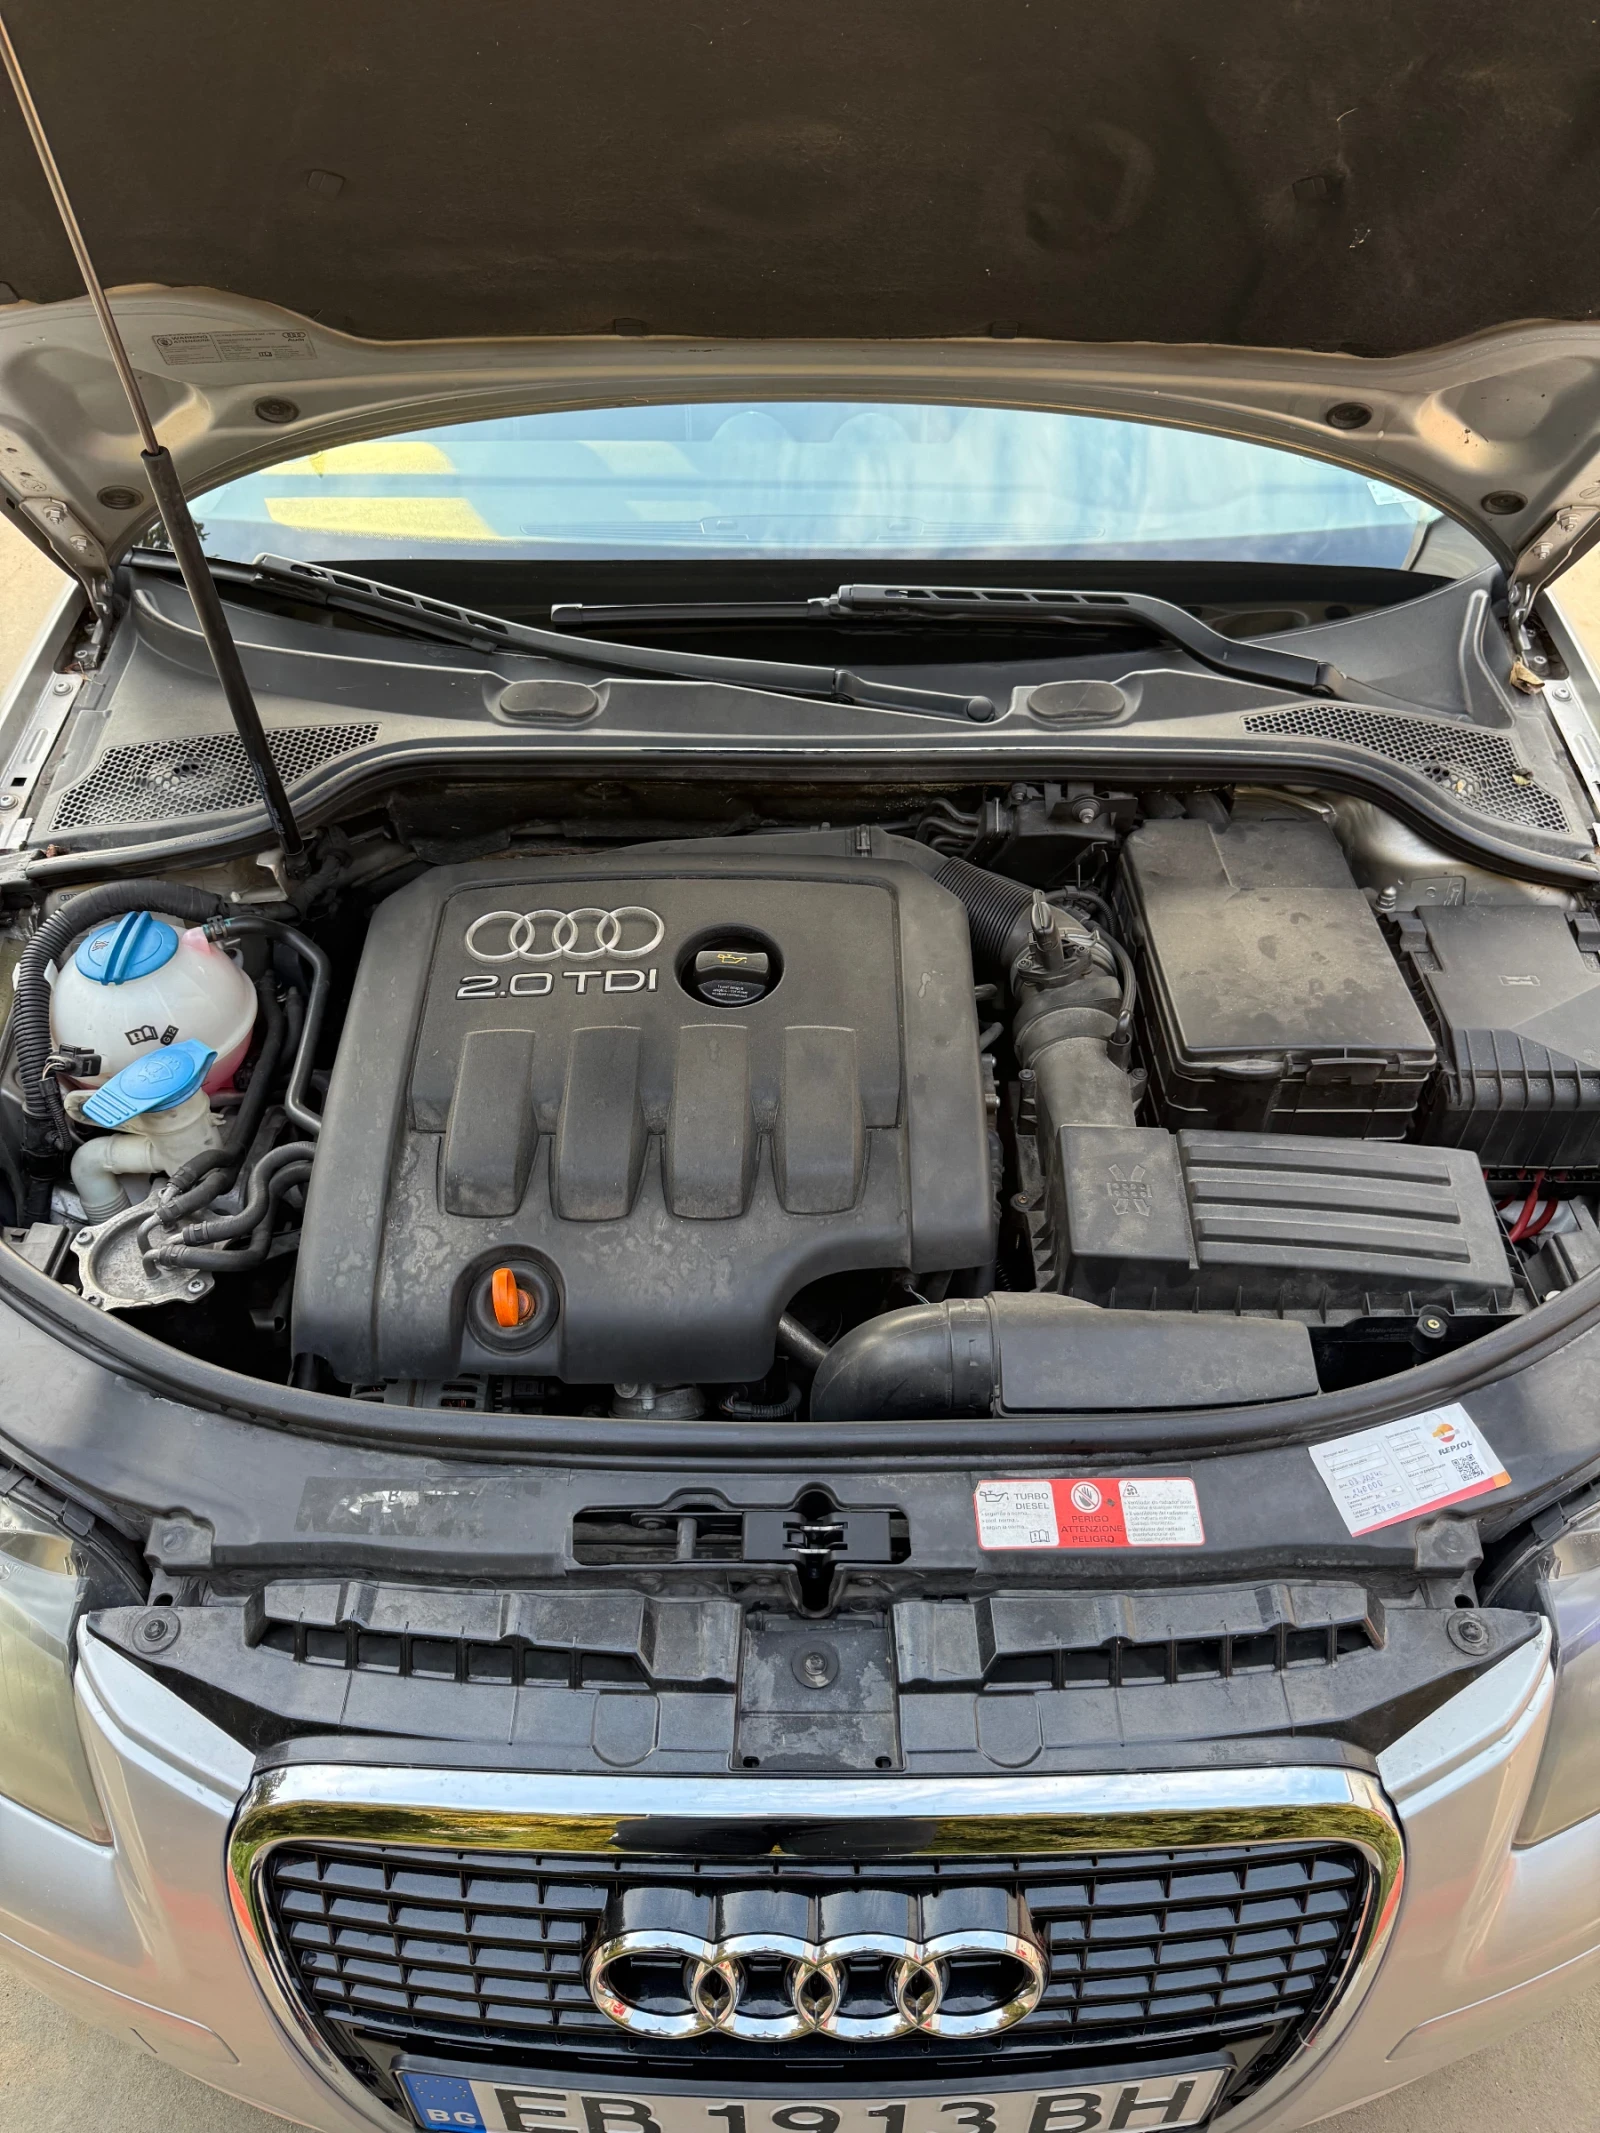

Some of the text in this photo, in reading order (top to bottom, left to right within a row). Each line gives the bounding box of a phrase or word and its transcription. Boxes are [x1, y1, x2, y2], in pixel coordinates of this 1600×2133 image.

[457, 969, 657, 999] 2.0 TDI
[162, 1027, 177, 1044] G12
[1438, 1440, 1472, 1456] REPSOL
[1014, 1492, 1049, 1500] TURBO
[1015, 1502, 1050, 1510] DIESEL
[1071, 1515, 1109, 1523] PERIGO
[1060, 1525, 1122, 1533] ATTENZIONE
[1072, 1535, 1115, 1544] PELIGRO
[494, 2088, 662, 2133] EB
[1028, 2080, 1198, 2133] BH
[427, 2108, 477, 2125] BG
